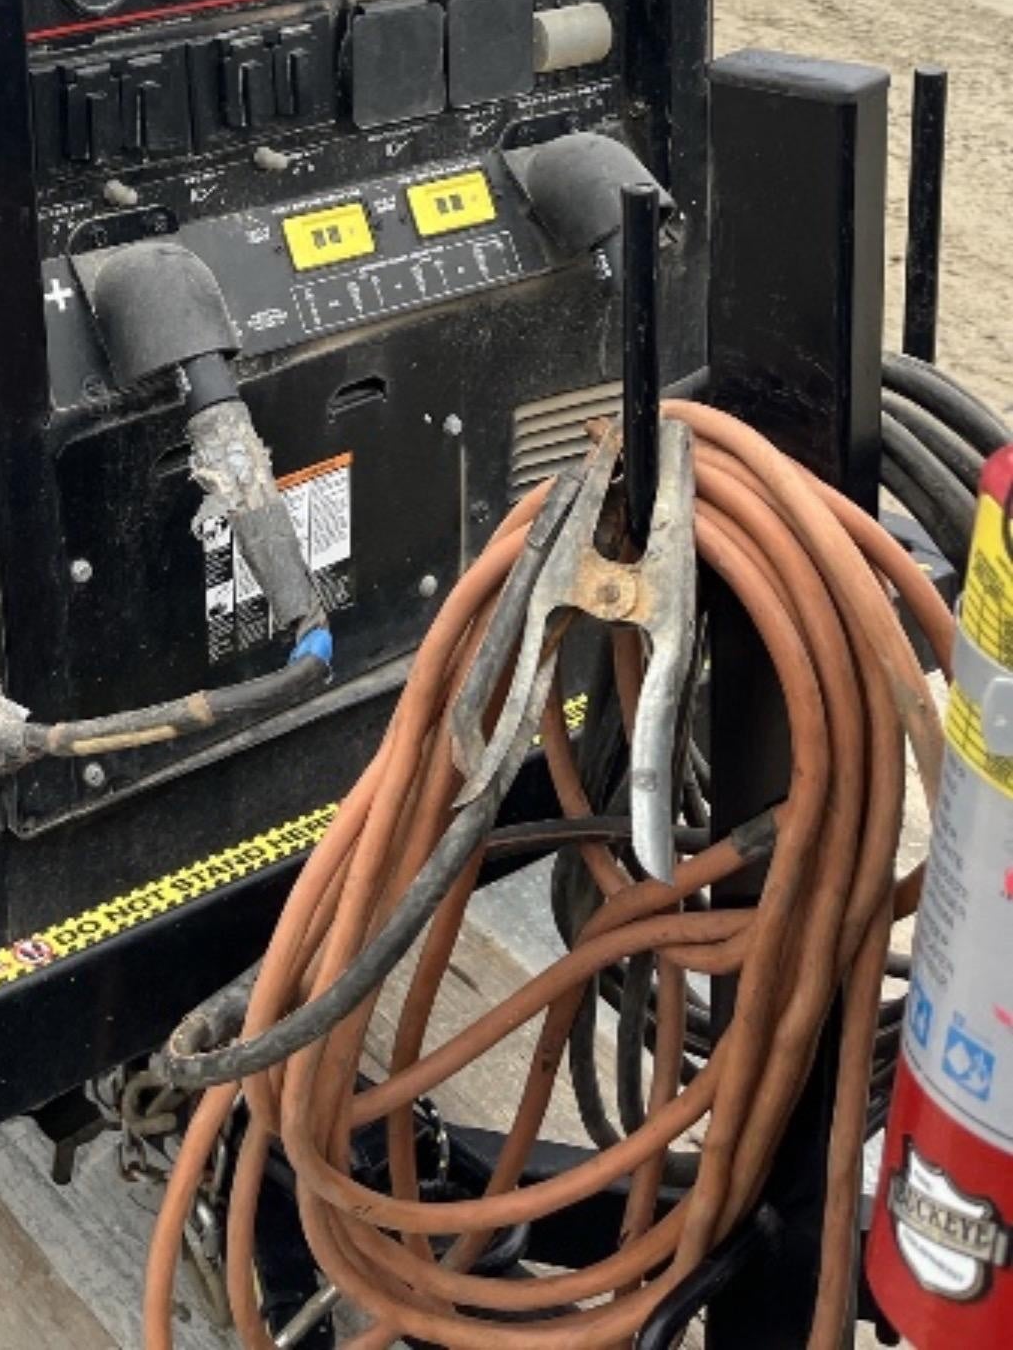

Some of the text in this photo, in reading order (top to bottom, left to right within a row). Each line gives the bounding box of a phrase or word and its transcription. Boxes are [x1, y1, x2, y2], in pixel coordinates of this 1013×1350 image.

[52, 918, 101, 947] DO
[106, 887, 167, 924] NOT
[169, 843, 267, 895] STAND
